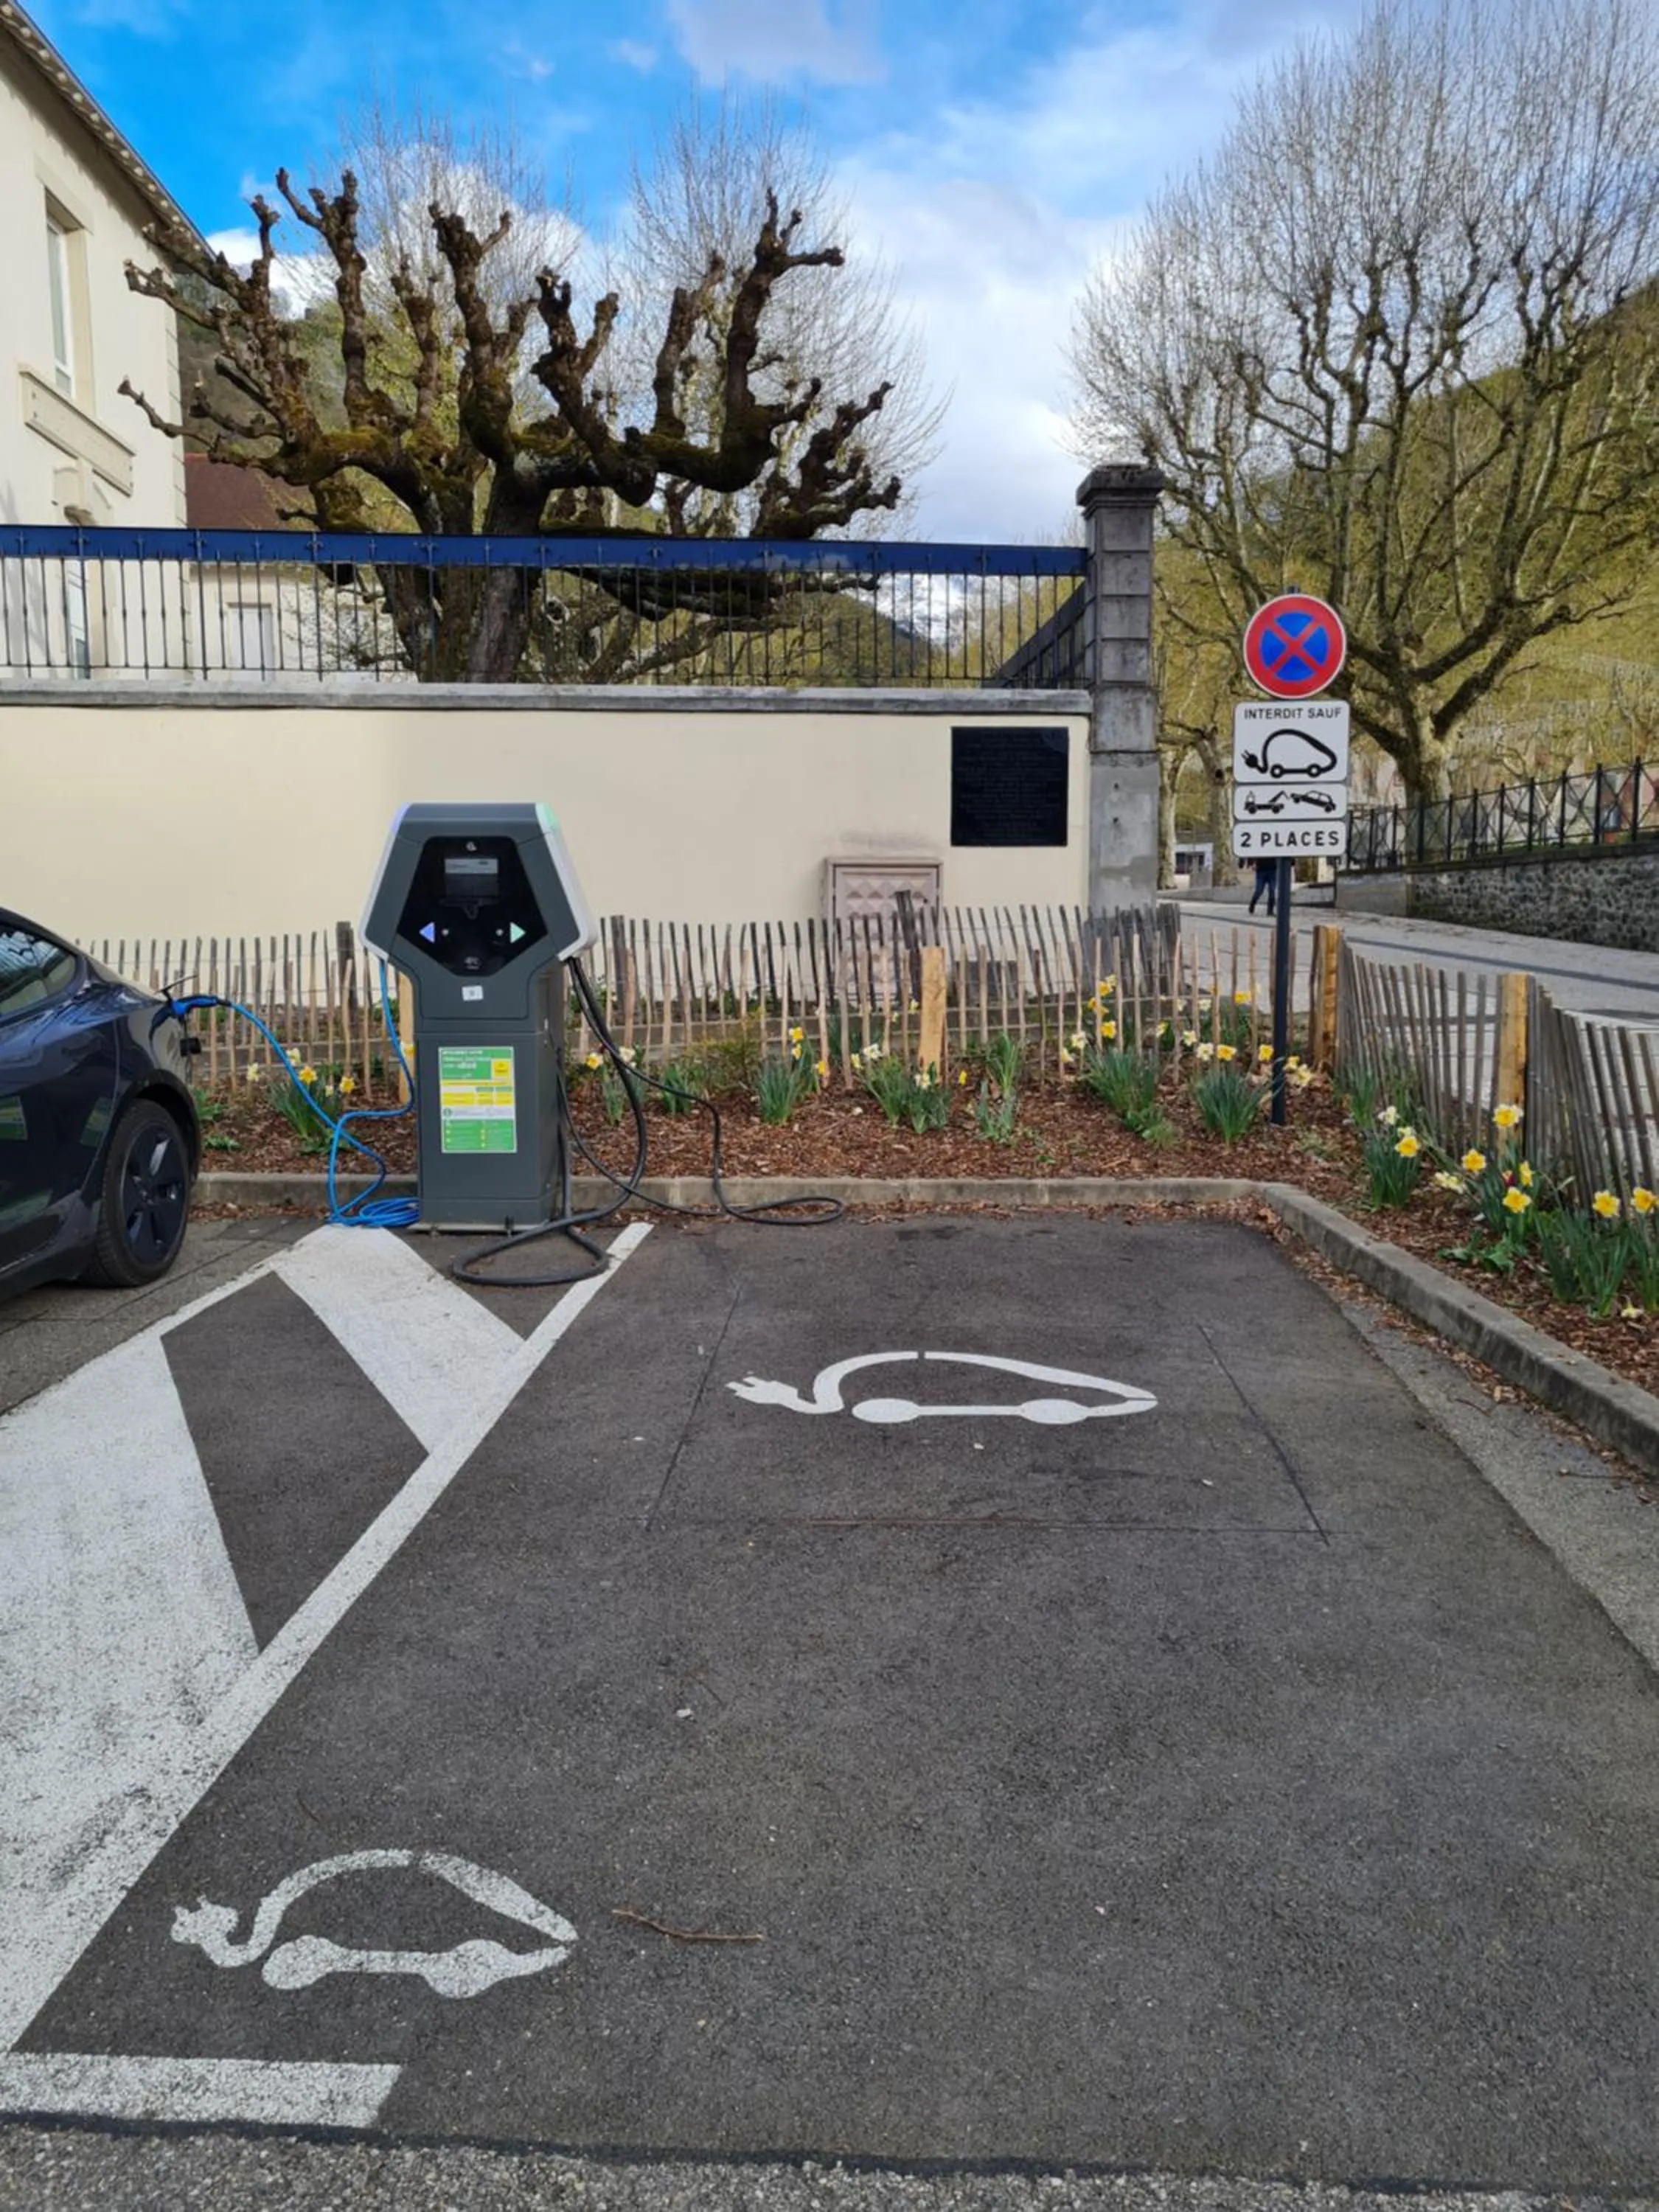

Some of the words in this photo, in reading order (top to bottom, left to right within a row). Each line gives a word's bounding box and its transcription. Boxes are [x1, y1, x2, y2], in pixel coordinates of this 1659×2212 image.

[1244, 707, 1304, 720] INTERDIT
[1307, 706, 1342, 719] SAUF
[1240, 832, 1252, 847] 2
[1260, 831, 1339, 847] PLACES
